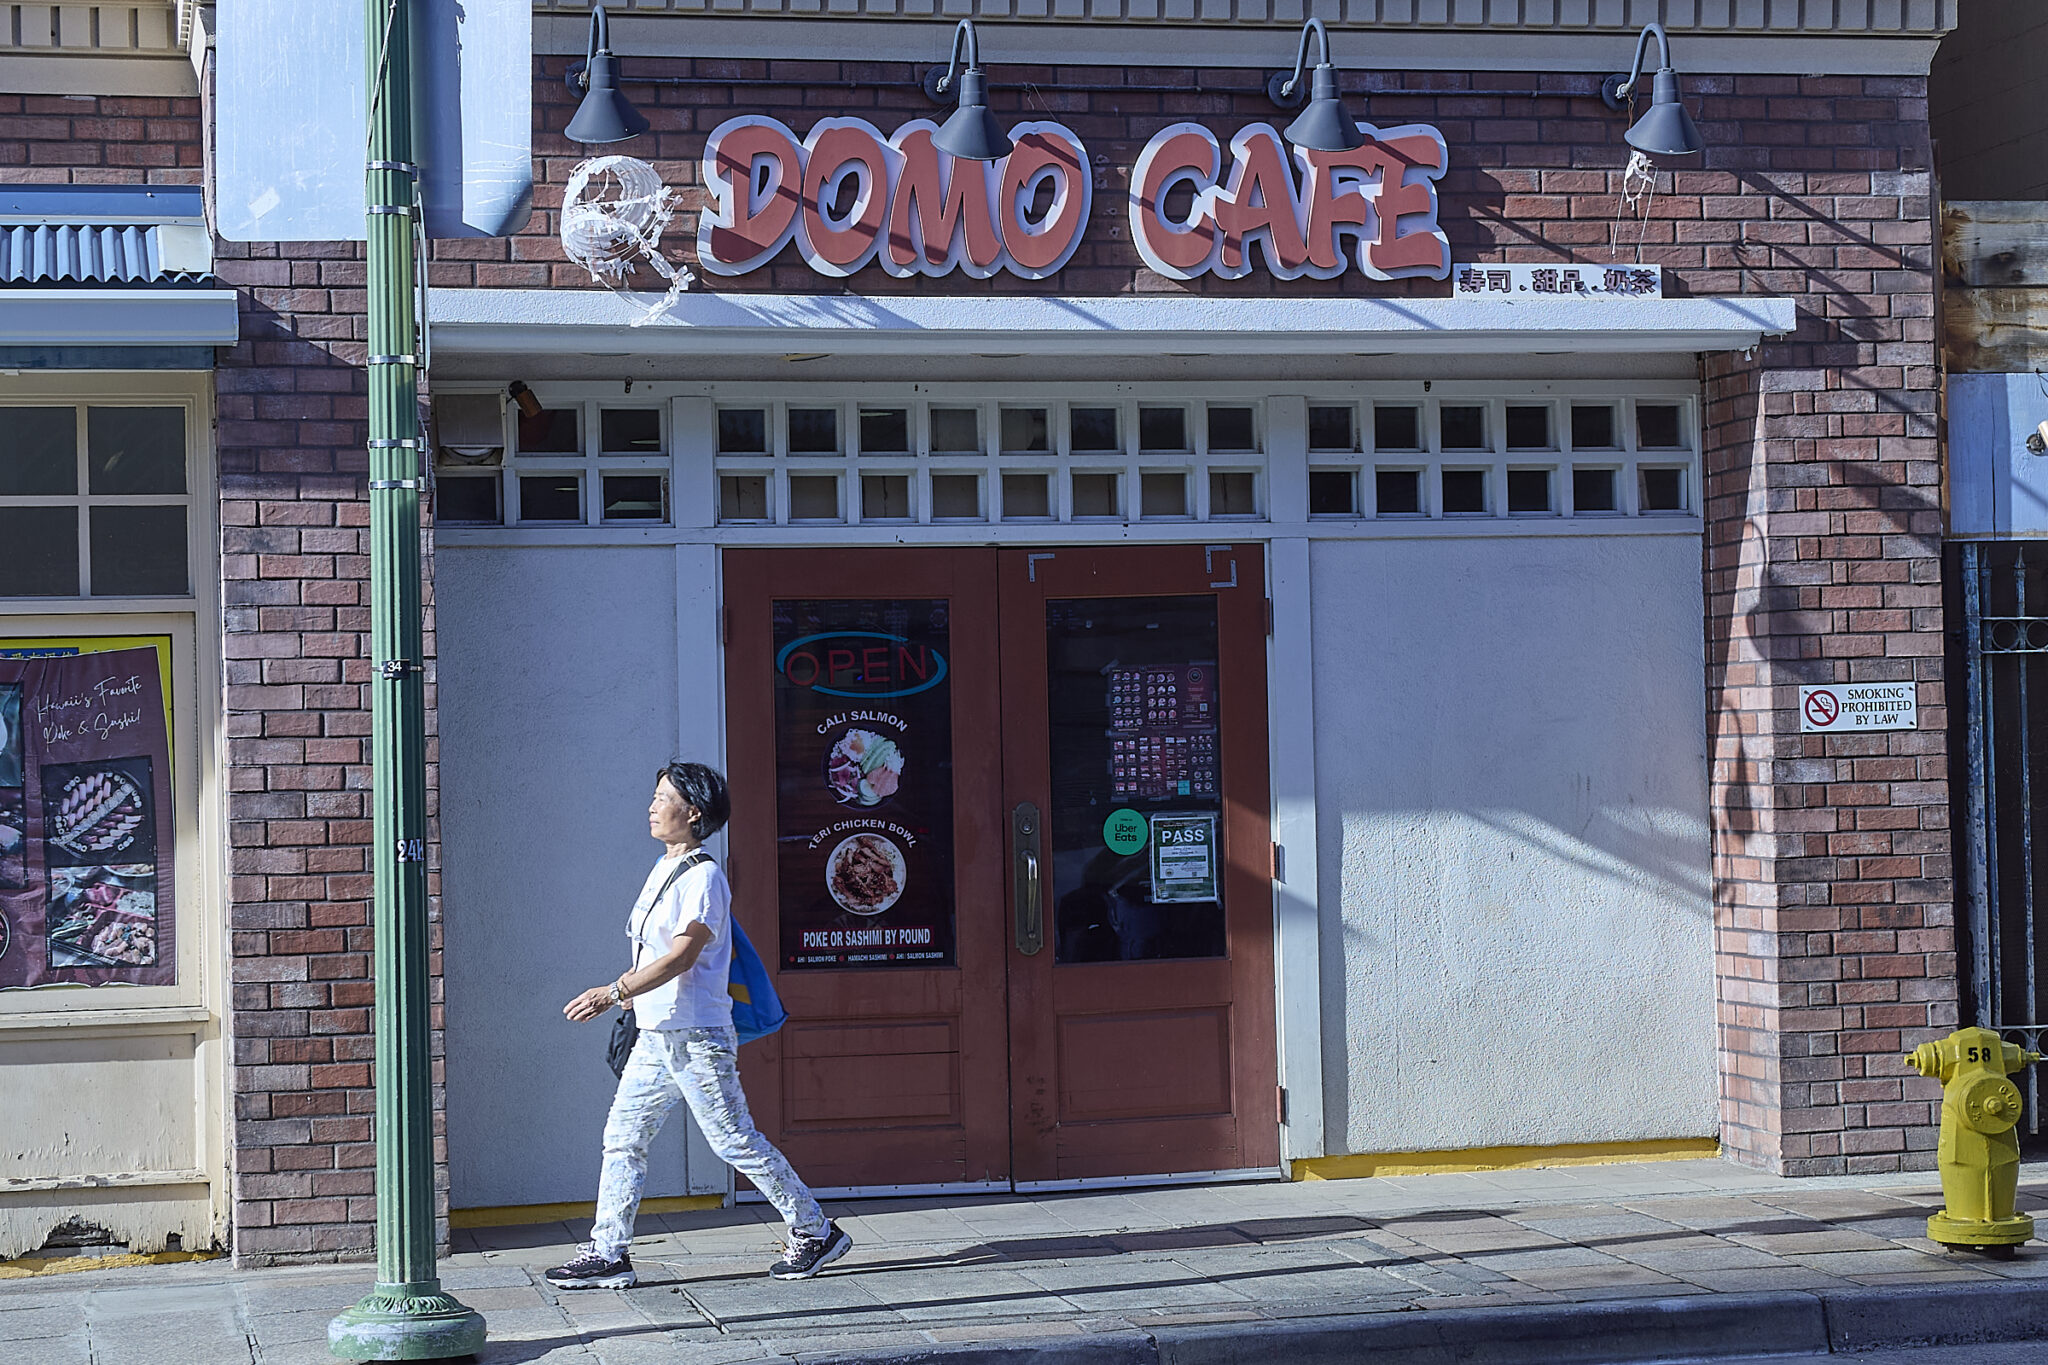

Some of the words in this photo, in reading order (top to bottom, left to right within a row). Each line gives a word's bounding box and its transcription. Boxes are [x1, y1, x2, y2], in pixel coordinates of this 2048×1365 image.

[699, 115, 1091, 279] DOMO
[1130, 122, 1449, 279] CAFE
[387, 660, 403, 673] 34
[786, 645, 927, 686] OPEN
[37, 693, 93, 723] Hawaii's
[93, 675, 142, 707] Favorite
[1848, 688, 1904, 700] SMOKING
[1841, 700, 1912, 713] PROHIBITED
[817, 713, 847, 735] CALI
[850, 711, 908, 732] SALMON
[1855, 714, 1870, 725] BY
[1874, 713, 1899, 725] LAW
[43, 721, 73, 753] Poke
[78, 720, 90, 735] &
[808, 827, 832, 850] TERI
[833, 819, 886, 832] CHICKEN
[888, 823, 917, 849] BOWL
[1115, 823, 1137, 833] Uber
[1161, 829, 1205, 843] PASS
[1114, 833, 1138, 842] Eats
[803, 931, 828, 948] POKE
[830, 931, 844, 947] OR
[845, 930, 883, 947] SASHIMI
[885, 929, 897, 945] BY
[899, 928, 931, 945] POUND
[1968, 1047, 1992, 1063] 58
